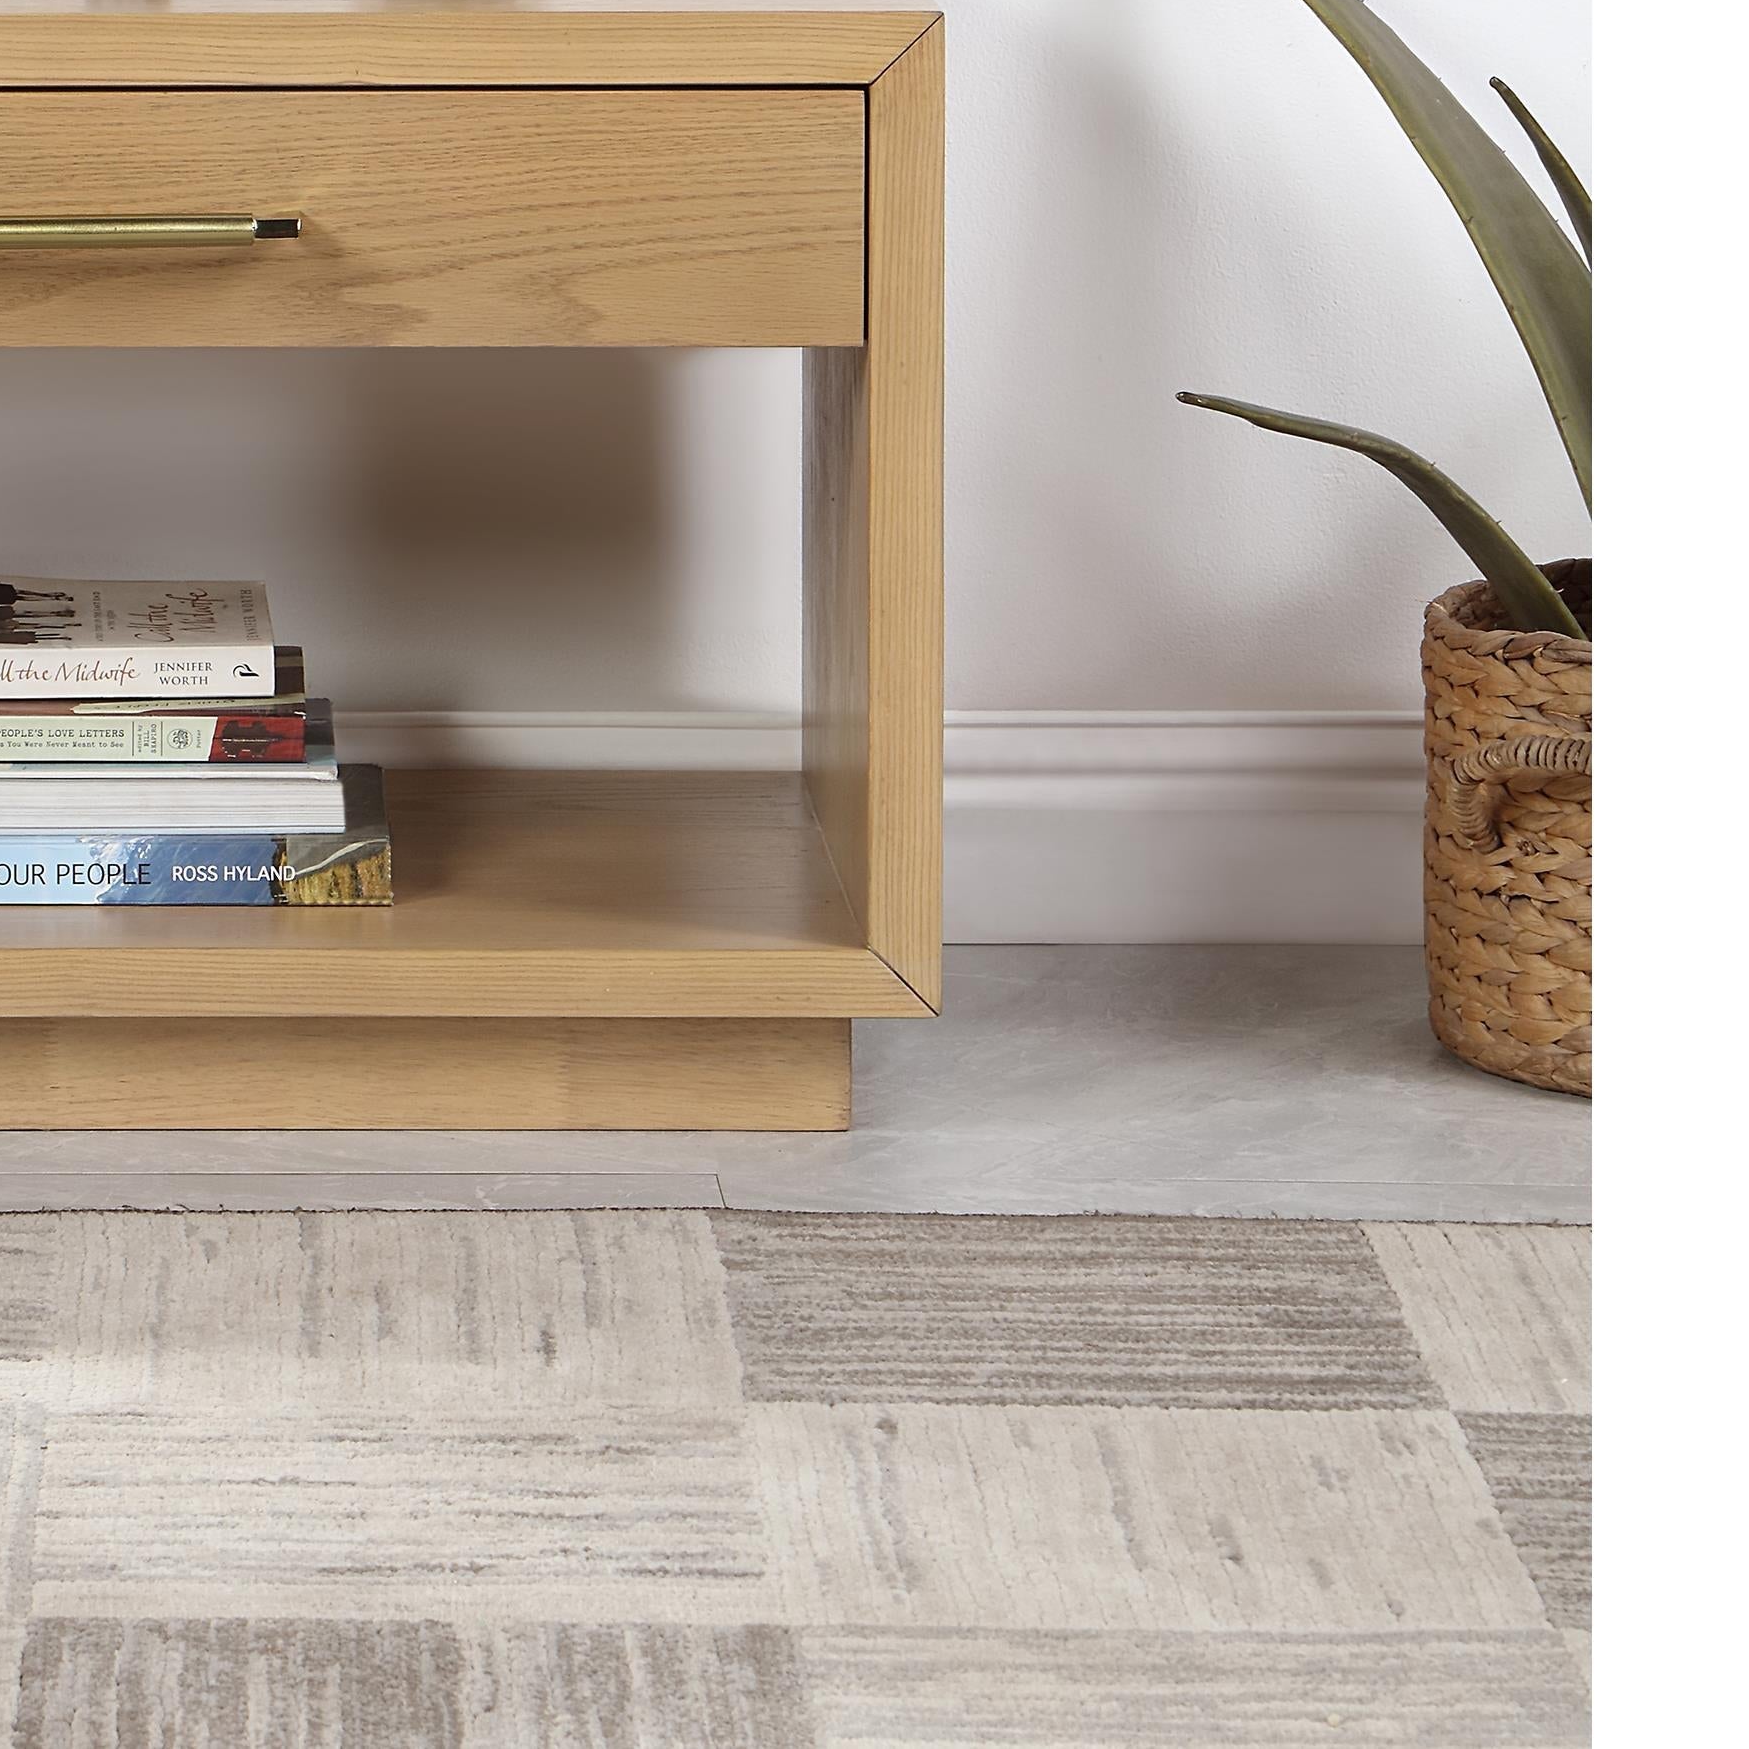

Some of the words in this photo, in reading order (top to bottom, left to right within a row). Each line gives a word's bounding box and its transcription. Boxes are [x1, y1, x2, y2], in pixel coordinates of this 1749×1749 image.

[165, 588, 225, 633] Midwife
[14, 659, 51, 681] the
[55, 657, 140, 686] Midwife
[154, 663, 212, 674] JENNIFER
[159, 676, 208, 685] WORTH
[48, 729, 74, 737] LOVE
[79, 729, 125, 737] LETTERS
[56, 862, 151, 885] PEOPLE
[172, 865, 218, 881] ROSS
[224, 865, 296, 881] HYLAND
